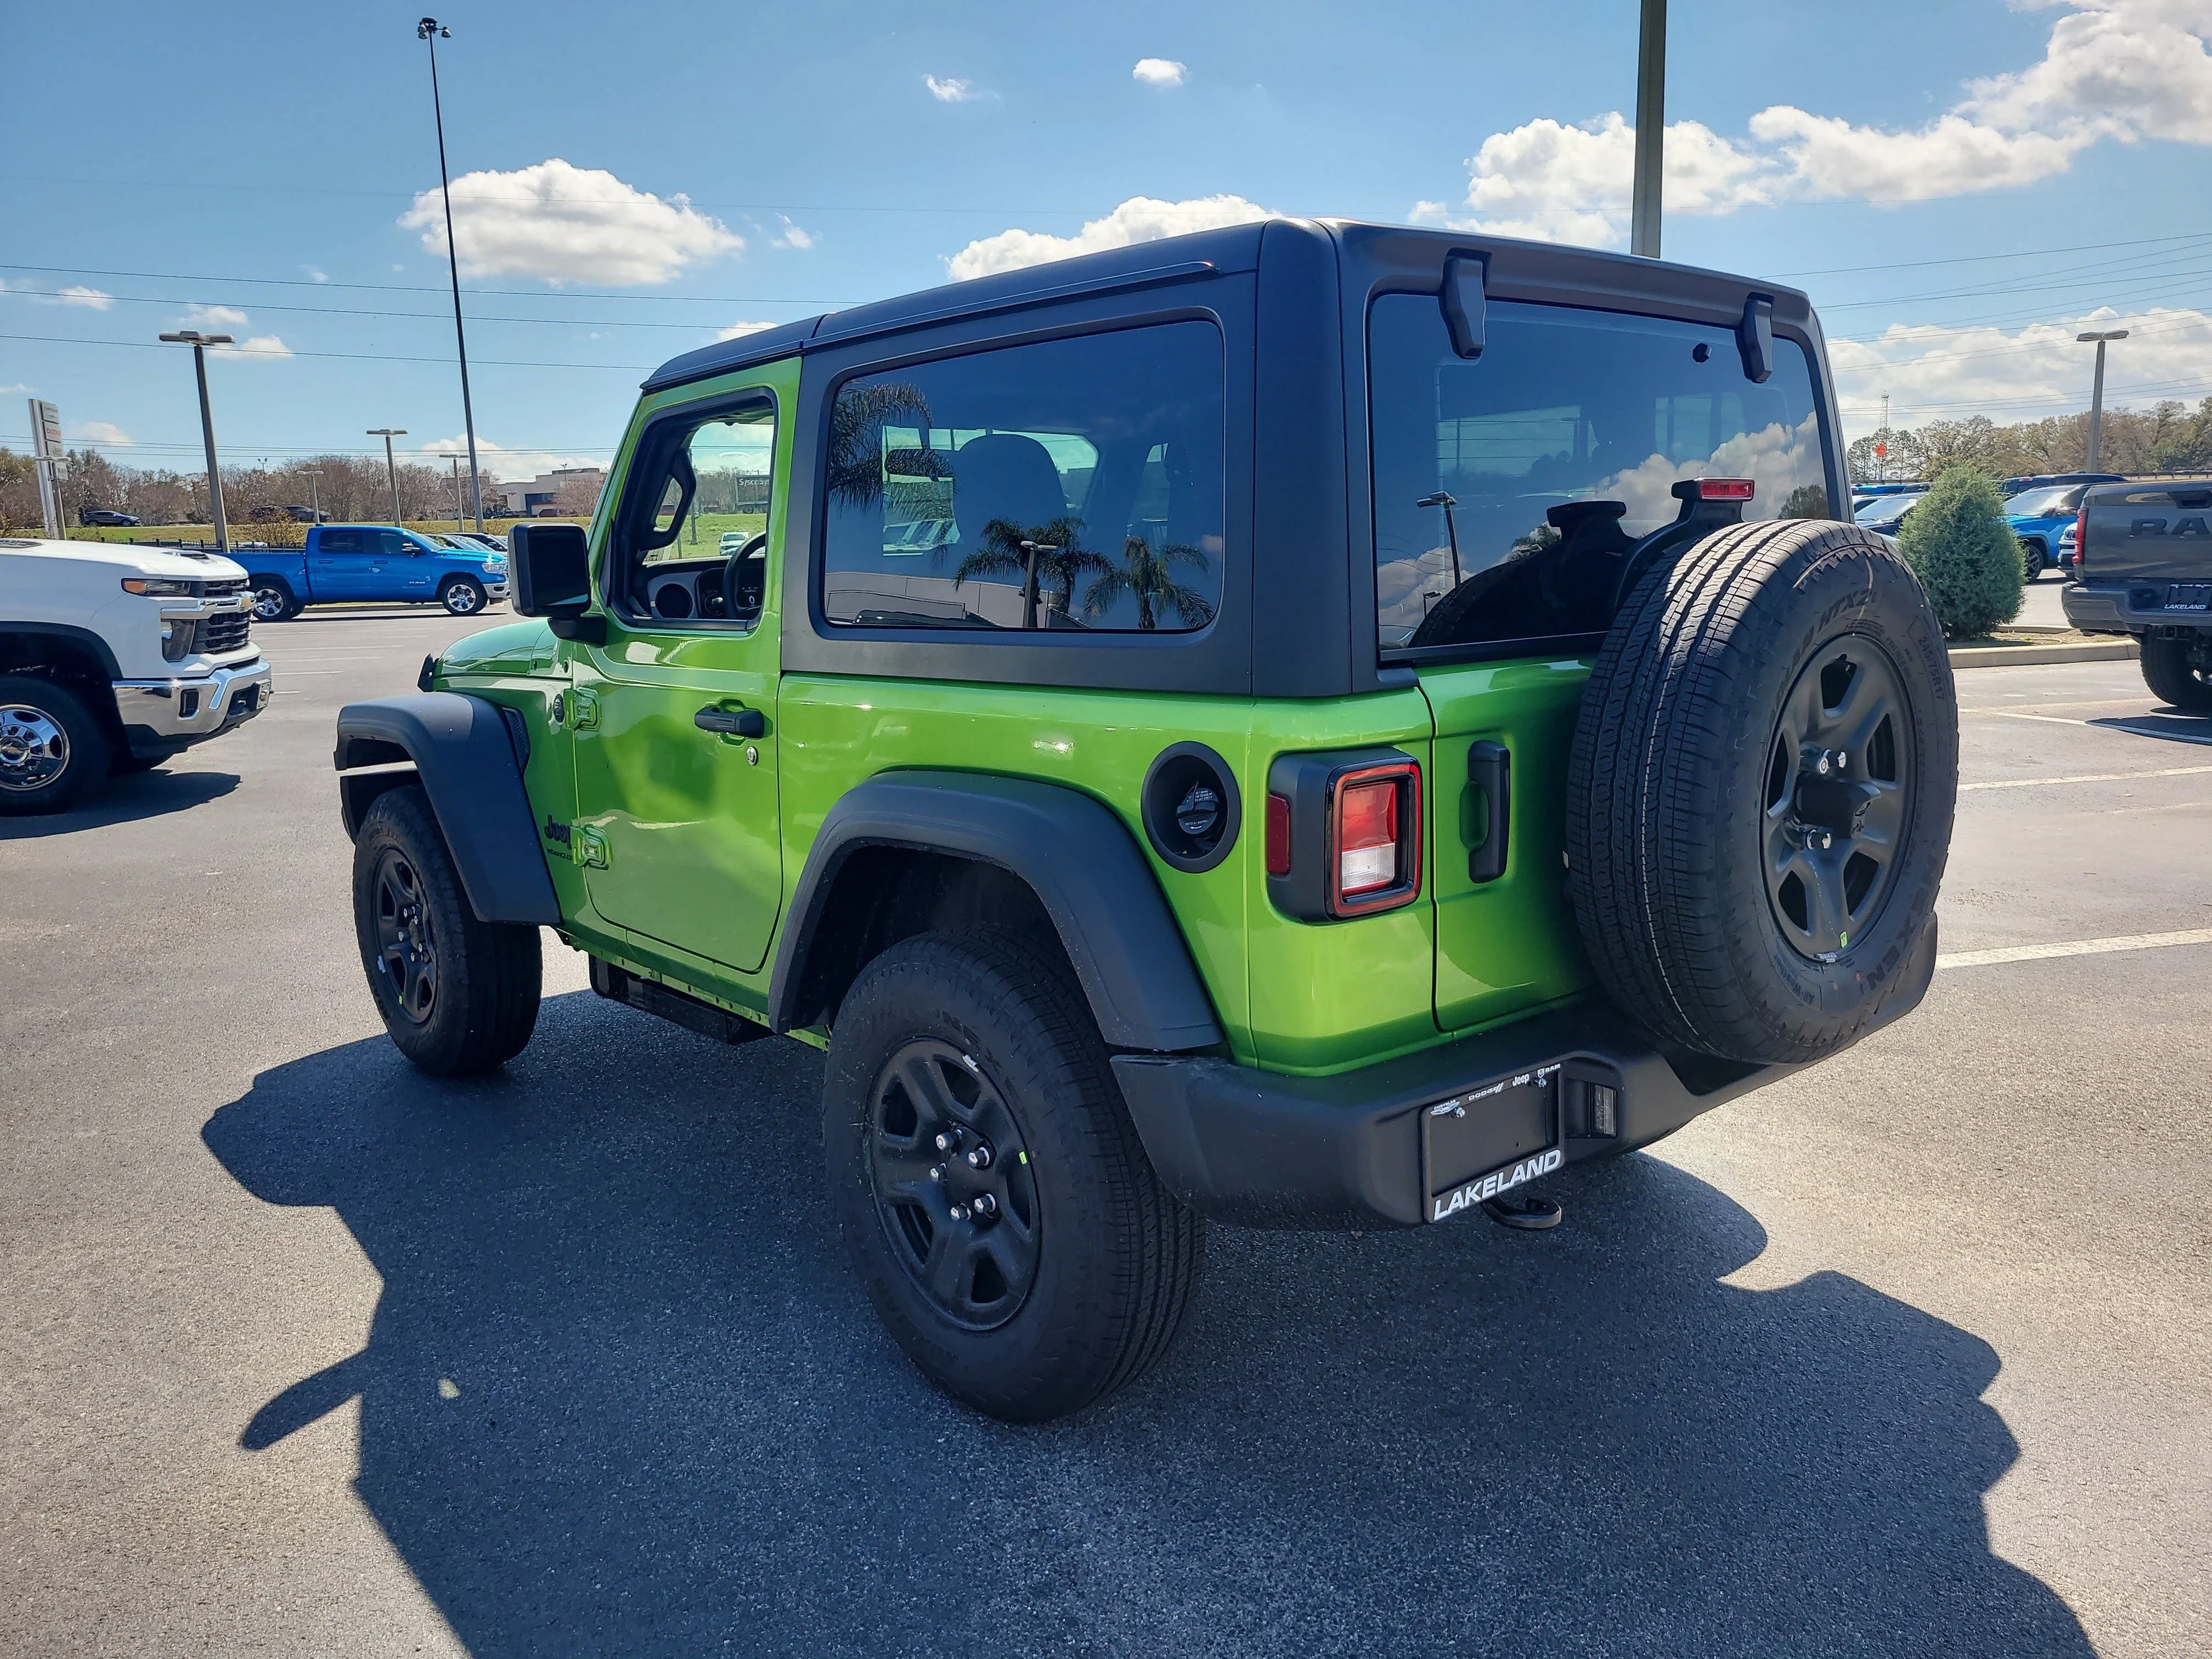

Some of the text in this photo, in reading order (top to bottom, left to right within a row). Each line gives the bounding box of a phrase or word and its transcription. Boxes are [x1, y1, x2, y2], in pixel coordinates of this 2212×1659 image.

[544, 814, 572, 850] Jeep
[1434, 1100, 1456, 1109] CHRYSLER
[1512, 1073, 1530, 1086] Jeep
[1545, 1064, 1560, 1073] RAM
[1434, 1149, 1561, 1221] LAKELAND
